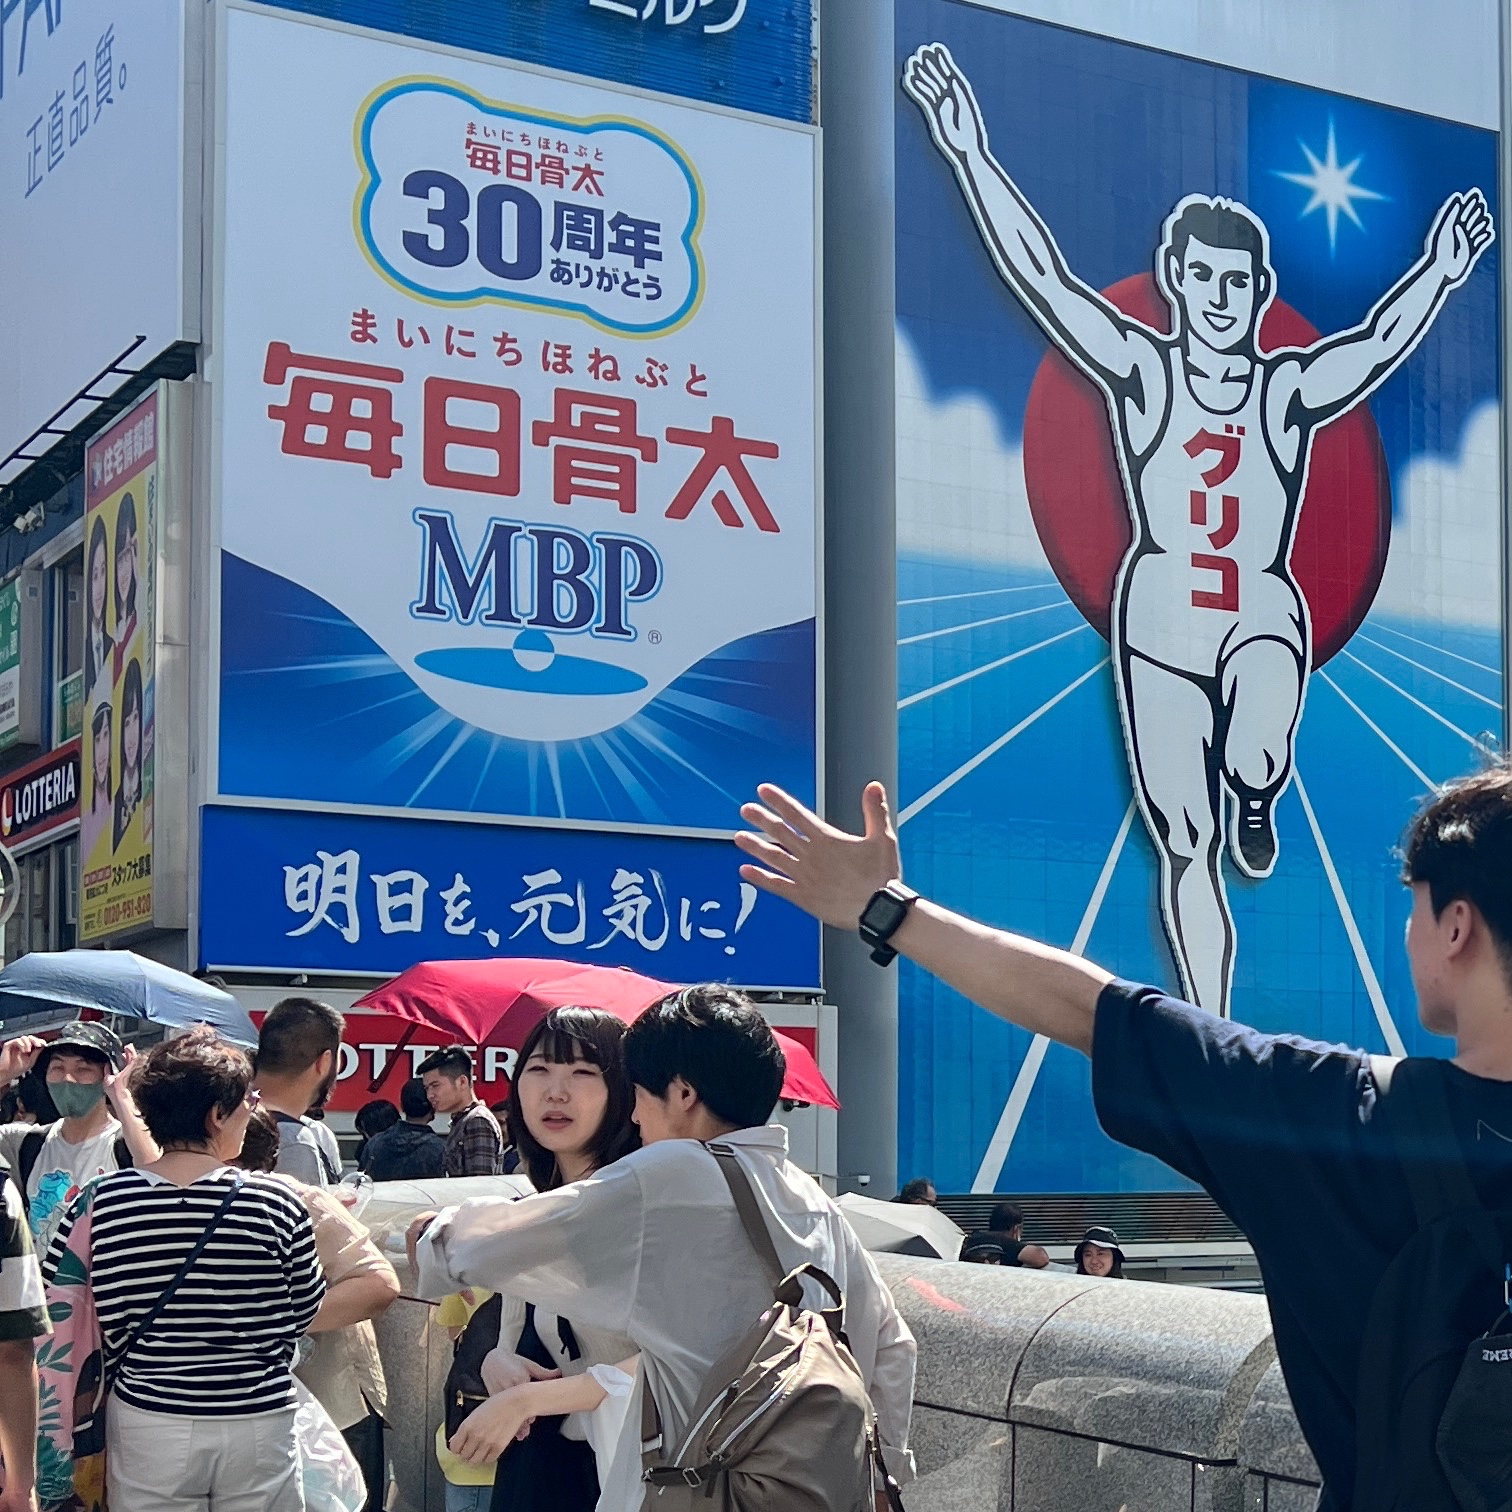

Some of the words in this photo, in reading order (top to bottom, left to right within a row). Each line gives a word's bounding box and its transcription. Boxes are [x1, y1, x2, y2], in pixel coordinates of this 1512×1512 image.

[25, 23, 127, 199] 正直品質。
[465, 121, 604, 162] まいにちほねぶと
[465, 138, 605, 197] 毎日骨太
[403, 170, 662, 281] 30周年
[550, 259, 662, 300] ありがとう
[350, 307, 709, 397] まいにちほねぶと
[263, 341, 780, 534] 毎日骨太
[1183, 424, 1245, 612] グリコ
[412, 508, 661, 640] MBP
[15, 761, 76, 825] LOTTERIA
[283, 848, 761, 956] 明日を、元気に!
